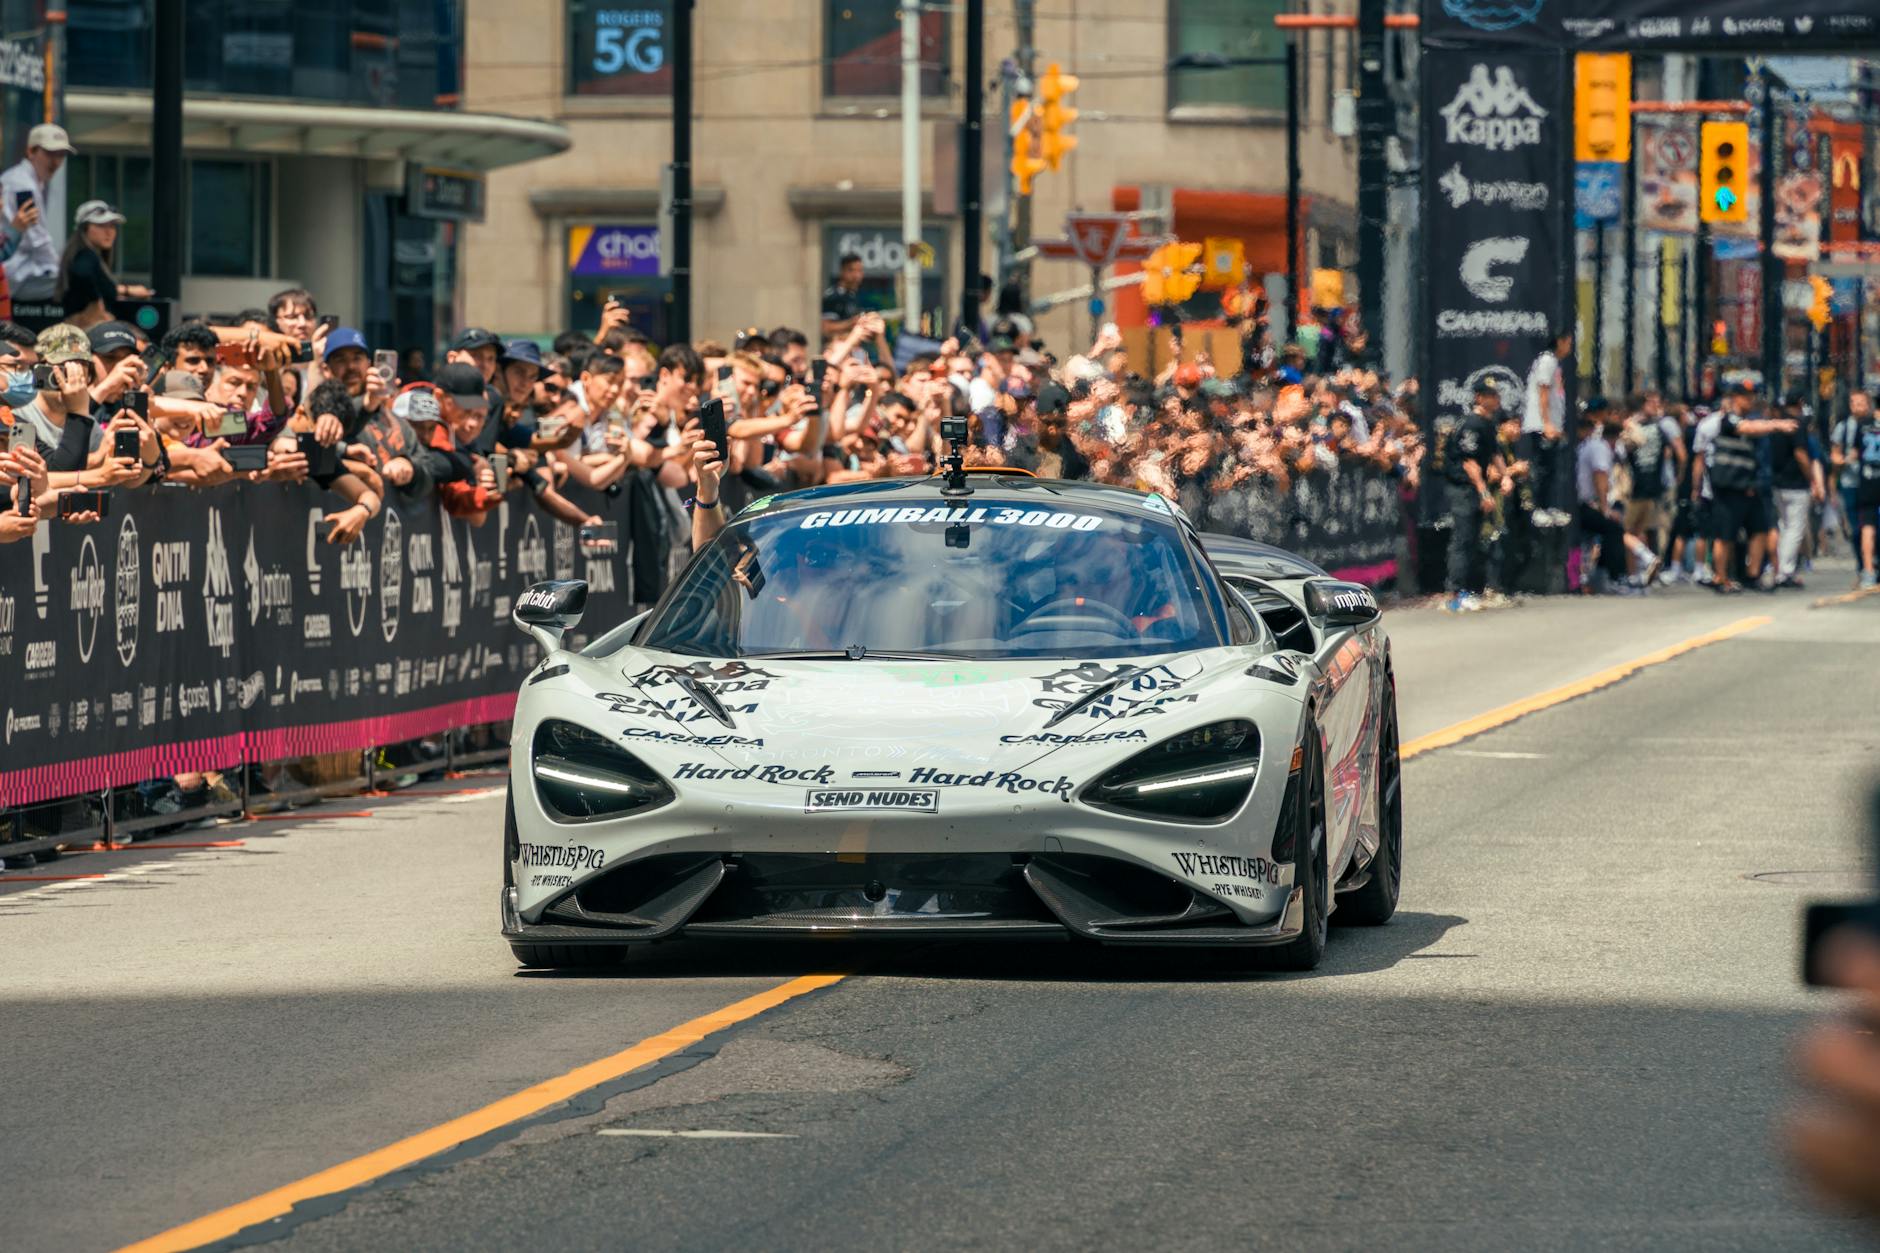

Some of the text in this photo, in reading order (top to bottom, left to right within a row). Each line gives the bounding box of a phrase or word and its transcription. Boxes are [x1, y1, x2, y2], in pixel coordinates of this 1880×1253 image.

[593, 28, 663, 72] 5G
[1446, 114, 1541, 150] Kappa
[800, 507, 1103, 531] GUMBALL 3000
[153, 541, 190, 589] QNTM
[156, 590, 184, 632] DNA
[529, 590, 556, 609] club
[1334, 590, 1362, 611] mph
[622, 728, 764, 747] CARRERA
[999, 729, 1148, 744] CARRERA
[673, 762, 835, 784] Hard Rock
[908, 766, 1074, 802] Hard Rock
[812, 791, 933, 808] SEND NUDES
